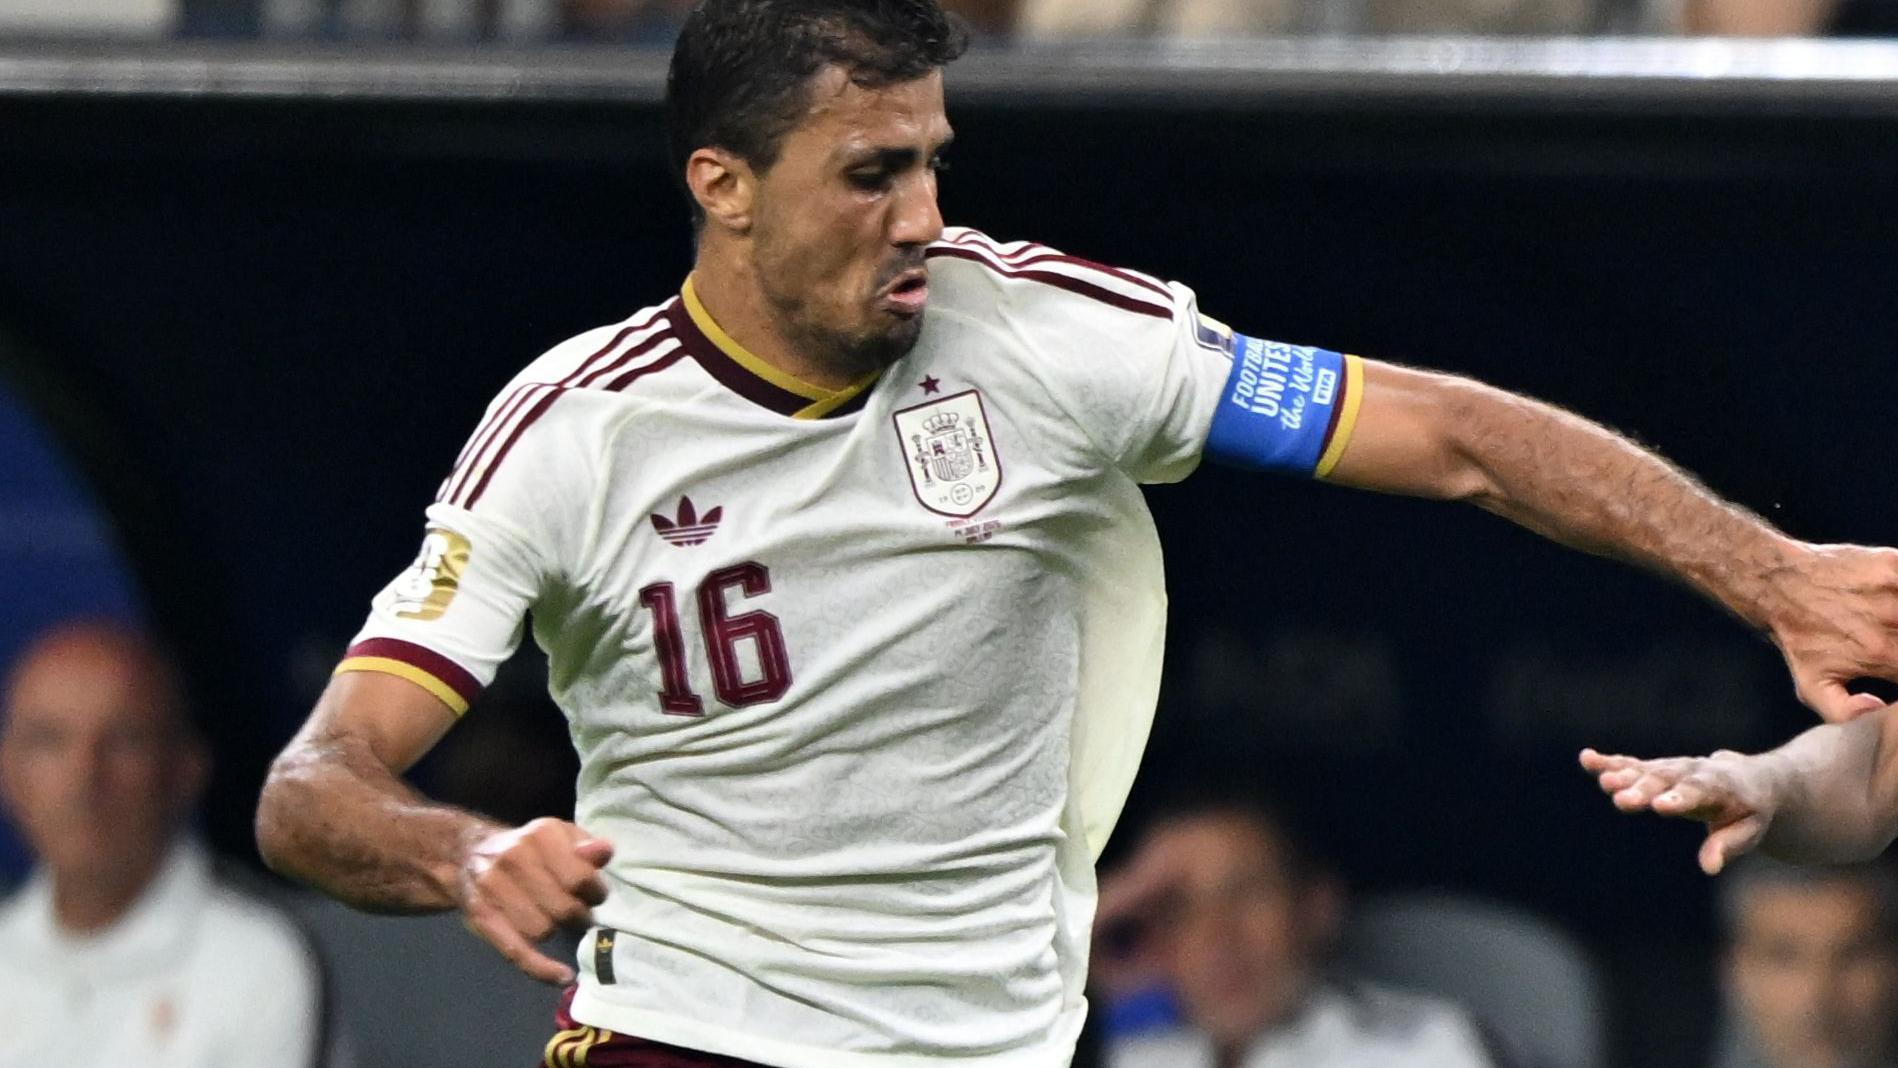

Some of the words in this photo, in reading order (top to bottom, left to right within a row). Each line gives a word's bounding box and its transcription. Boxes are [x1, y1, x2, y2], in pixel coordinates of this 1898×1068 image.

[1232, 338, 1264, 409] FOOTBA
[1250, 340, 1292, 417] UNITES
[1280, 393, 1306, 430] the
[639, 561, 792, 717] 16
